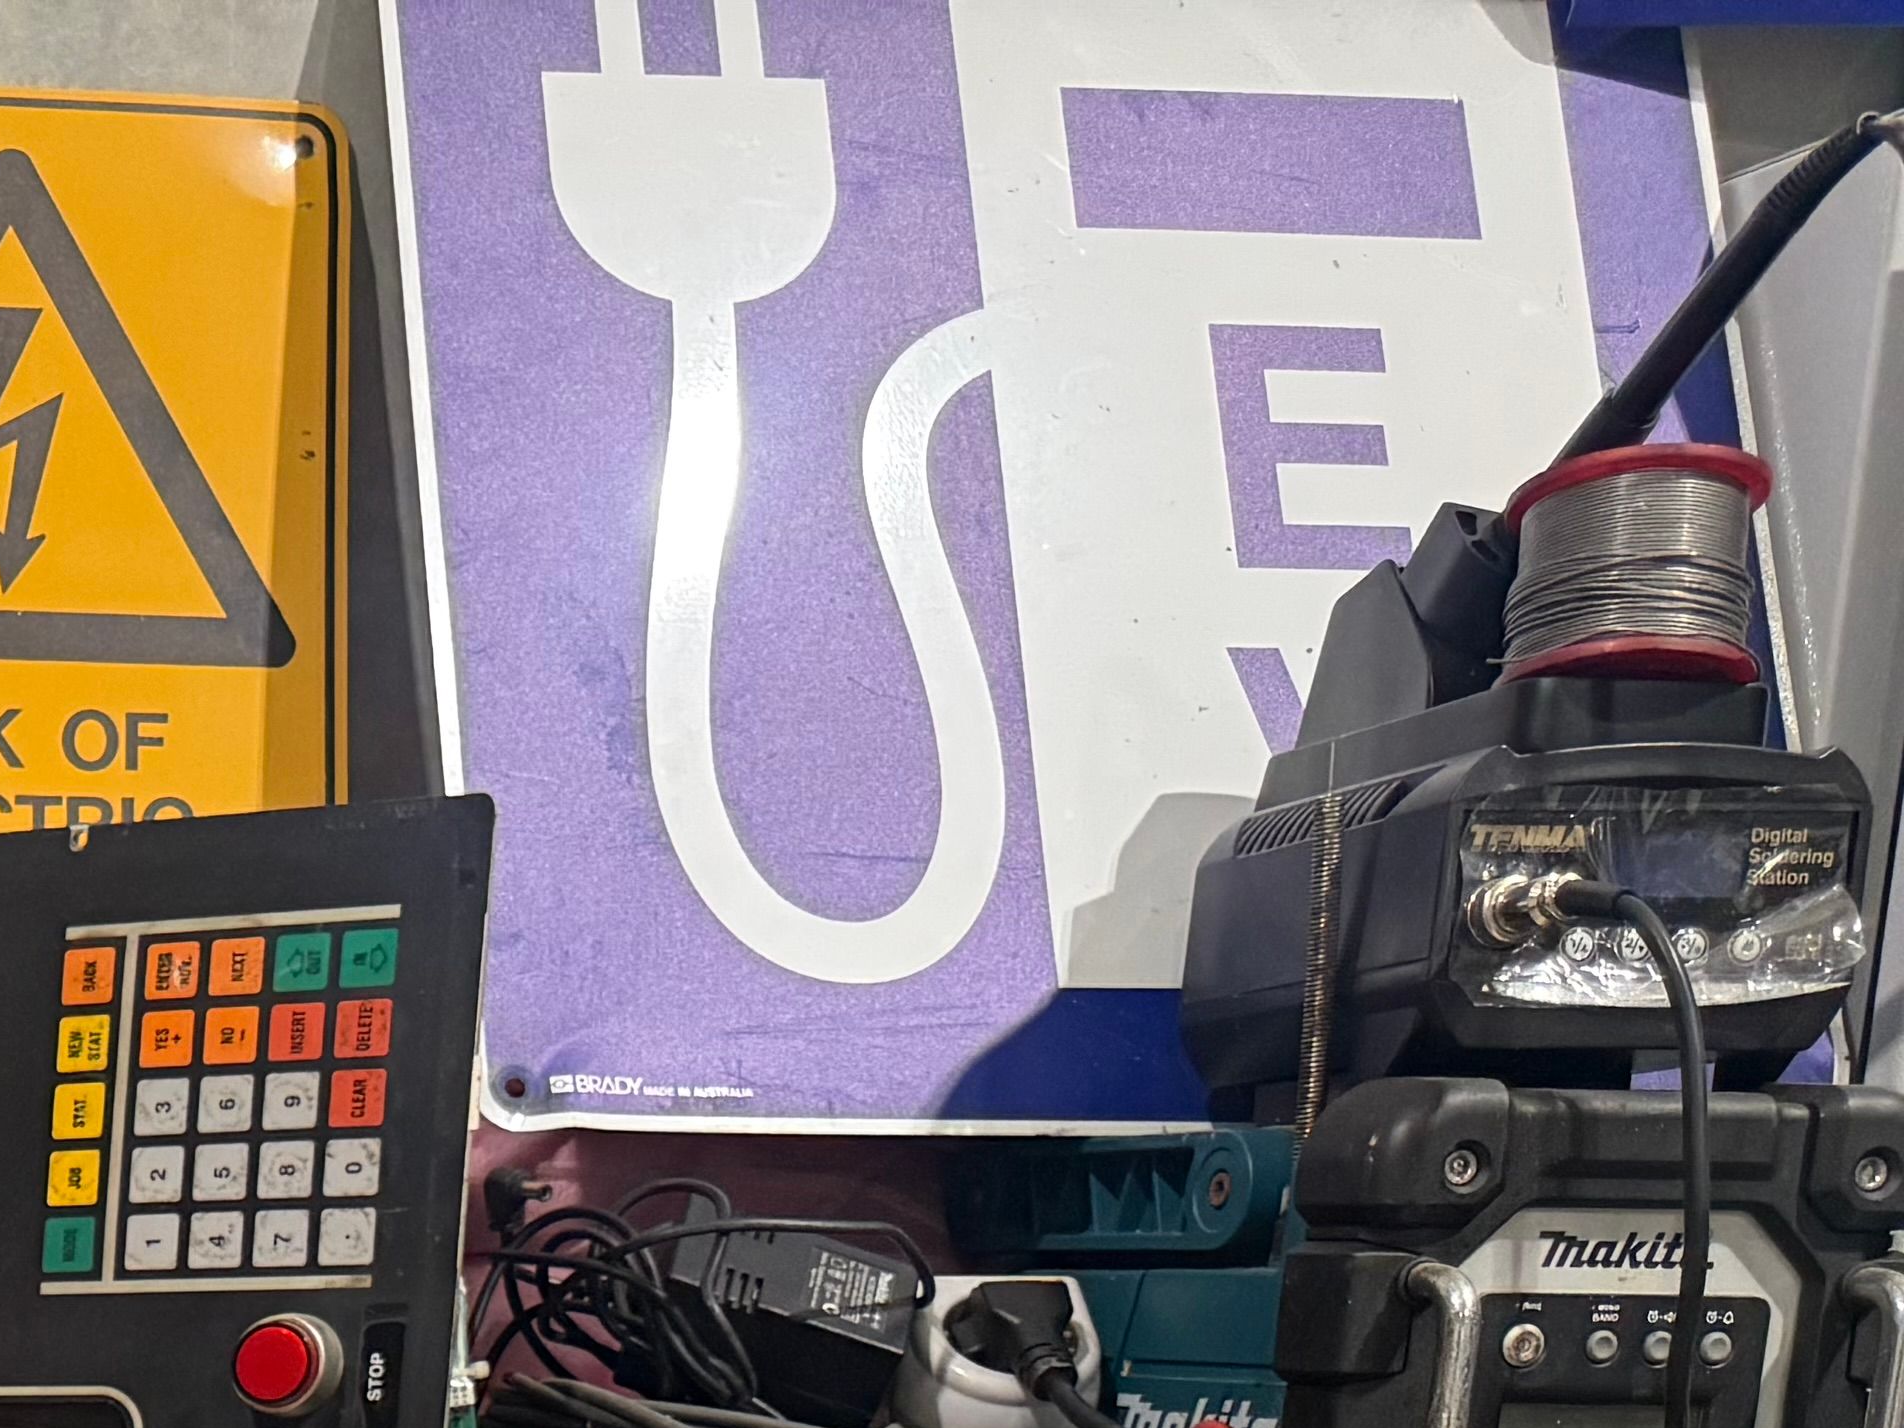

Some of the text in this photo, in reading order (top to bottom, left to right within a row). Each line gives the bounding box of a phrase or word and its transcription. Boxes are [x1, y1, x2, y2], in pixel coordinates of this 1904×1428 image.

[60, 709, 170, 772] OF
[1751, 827, 1808, 846] Digital
[155, 1027, 169, 1052] YES
[291, 1010, 306, 1055] INSERT
[357, 1005, 373, 1052] DELETE
[352, 1079, 366, 1118] CLEAR
[575, 1075, 641, 1095] BRADY
[1539, 1231, 1713, 1269] Makit
[368, 1351, 385, 1401] STOP
